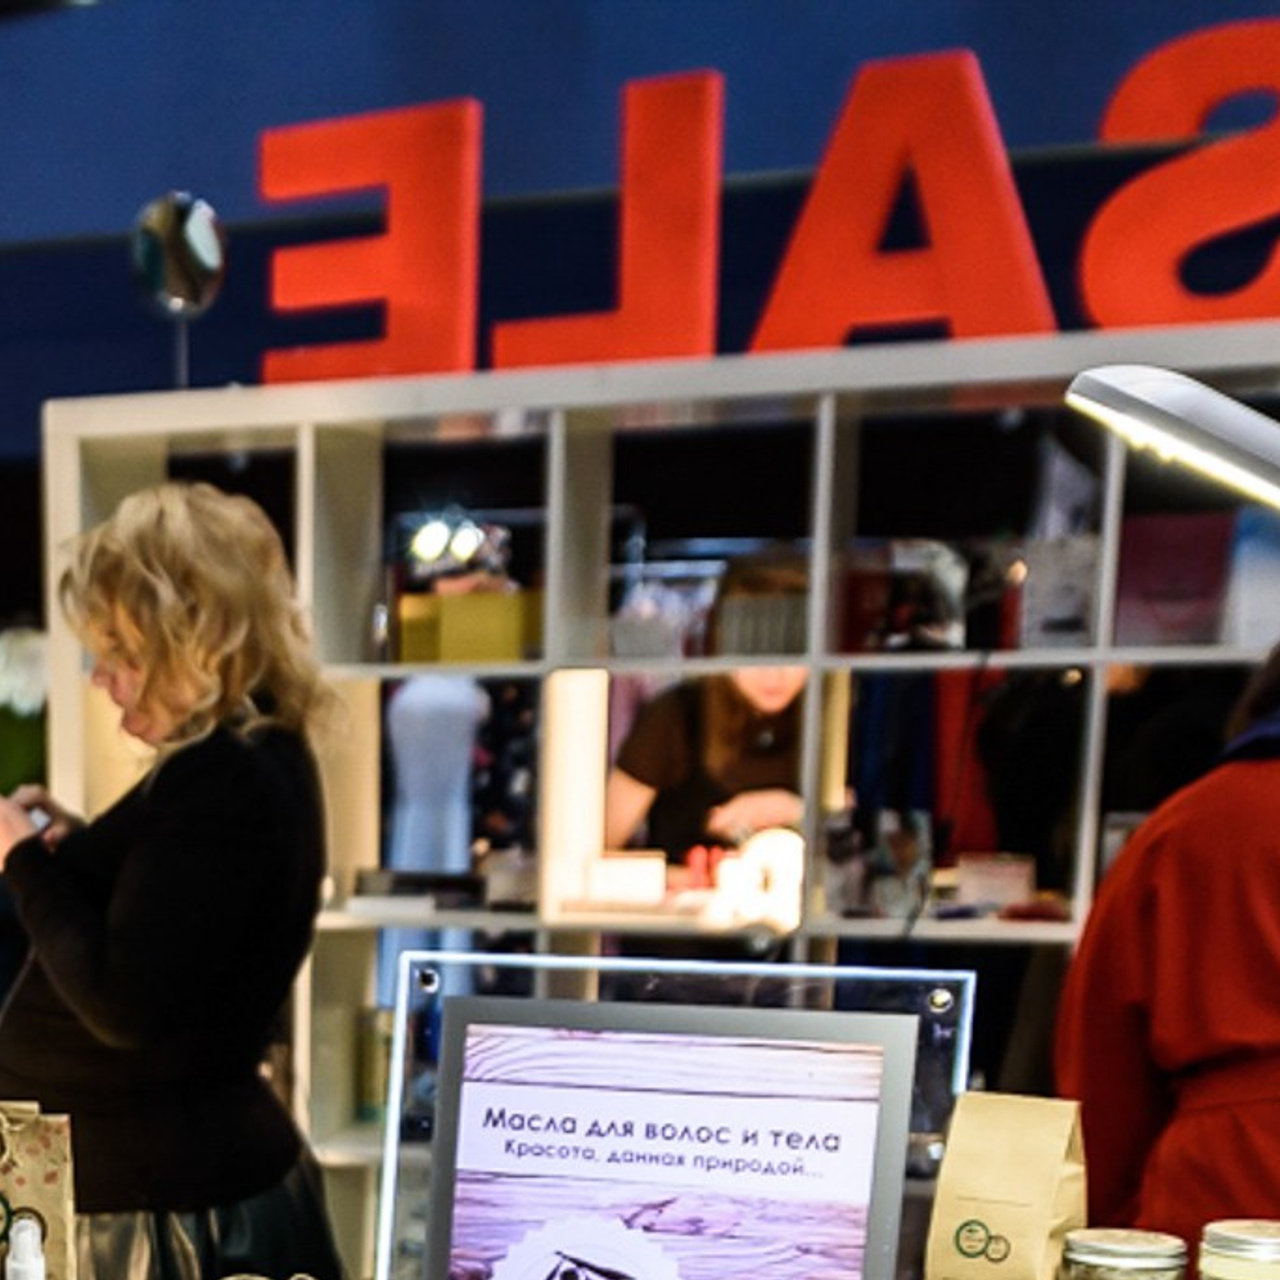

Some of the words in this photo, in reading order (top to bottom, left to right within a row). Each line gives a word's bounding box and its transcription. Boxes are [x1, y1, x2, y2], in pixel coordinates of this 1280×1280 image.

[483, 1106, 577, 1134] Масла
[585, 1119, 634, 1138] для
[645, 1122, 731, 1144] волос
[742, 1129, 759, 1146] и
[770, 1130, 841, 1152] тела
[607, 1149, 685, 1167] данная
